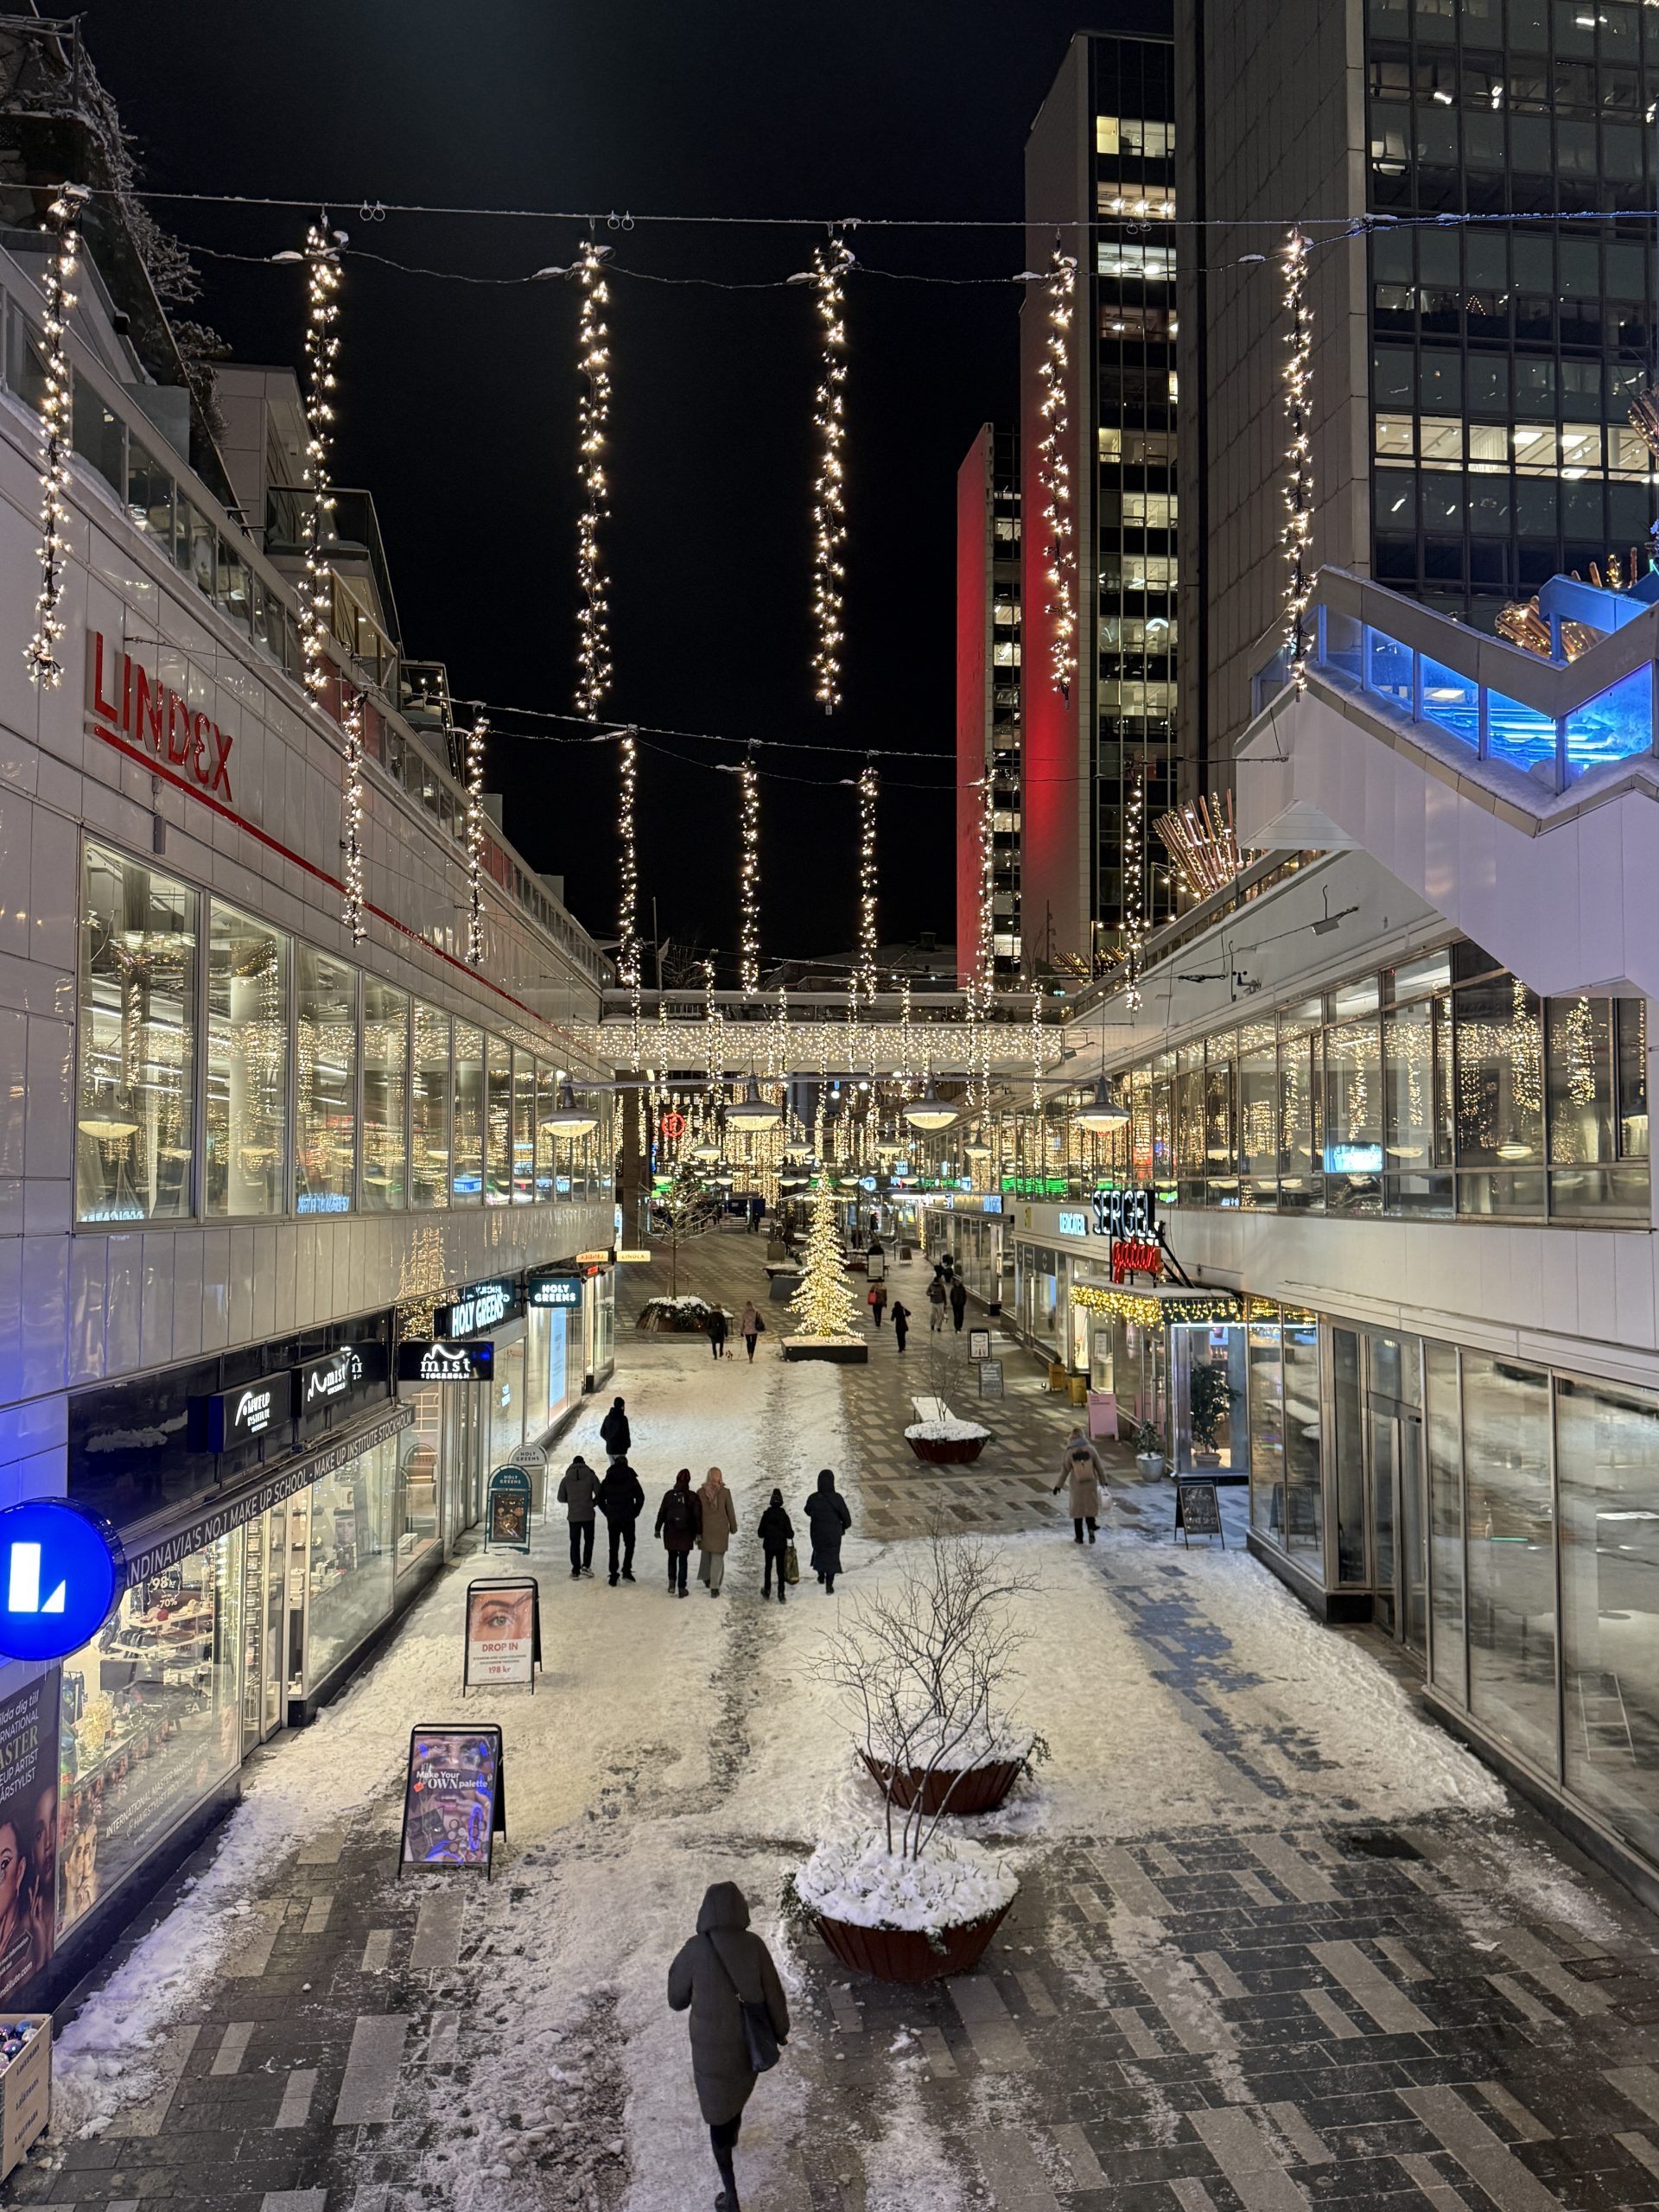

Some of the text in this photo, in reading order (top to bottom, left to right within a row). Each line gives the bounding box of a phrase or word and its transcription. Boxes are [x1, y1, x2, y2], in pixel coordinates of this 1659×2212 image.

[92, 631, 233, 803] LINDEX
[1092, 1190, 1156, 1237] SERGEL
[535, 1294, 576, 1302] GREENS
[542, 1285, 569, 1294] HOLY
[452, 1294, 504, 1338] HOLY GREENS
[421, 1359, 470, 1372] mist
[126, 1526, 202, 1587] NDINAVIA'S
[230, 1496, 257, 1529] MAKE
[259, 1488, 273, 1510] UP
[274, 1472, 308, 1503] SCHOOL
[314, 1456, 334, 1479] MAKE
[336, 1448, 346, 1465] UP
[347, 1429, 378, 1461] INSTITUTE
[378, 1410, 411, 1442] STOCKHOLM
[482, 1643, 506, 1652] DROP
[0, 1689, 39, 1726] ilda dig till
[0, 1707, 39, 1744] RNATIONAL
[0, 1725, 39, 1771] ASTER
[0, 1748, 39, 1788] EUP ARTIST
[0, 1766, 36, 1805] ÅRSTYLIST
[416, 1770, 439, 1779] Make
[428, 1779, 488, 1789] OWN palette
[105, 1790, 151, 1839] INTERNATIONAL
[0, 1961, 33, 1999] nstitute.com
